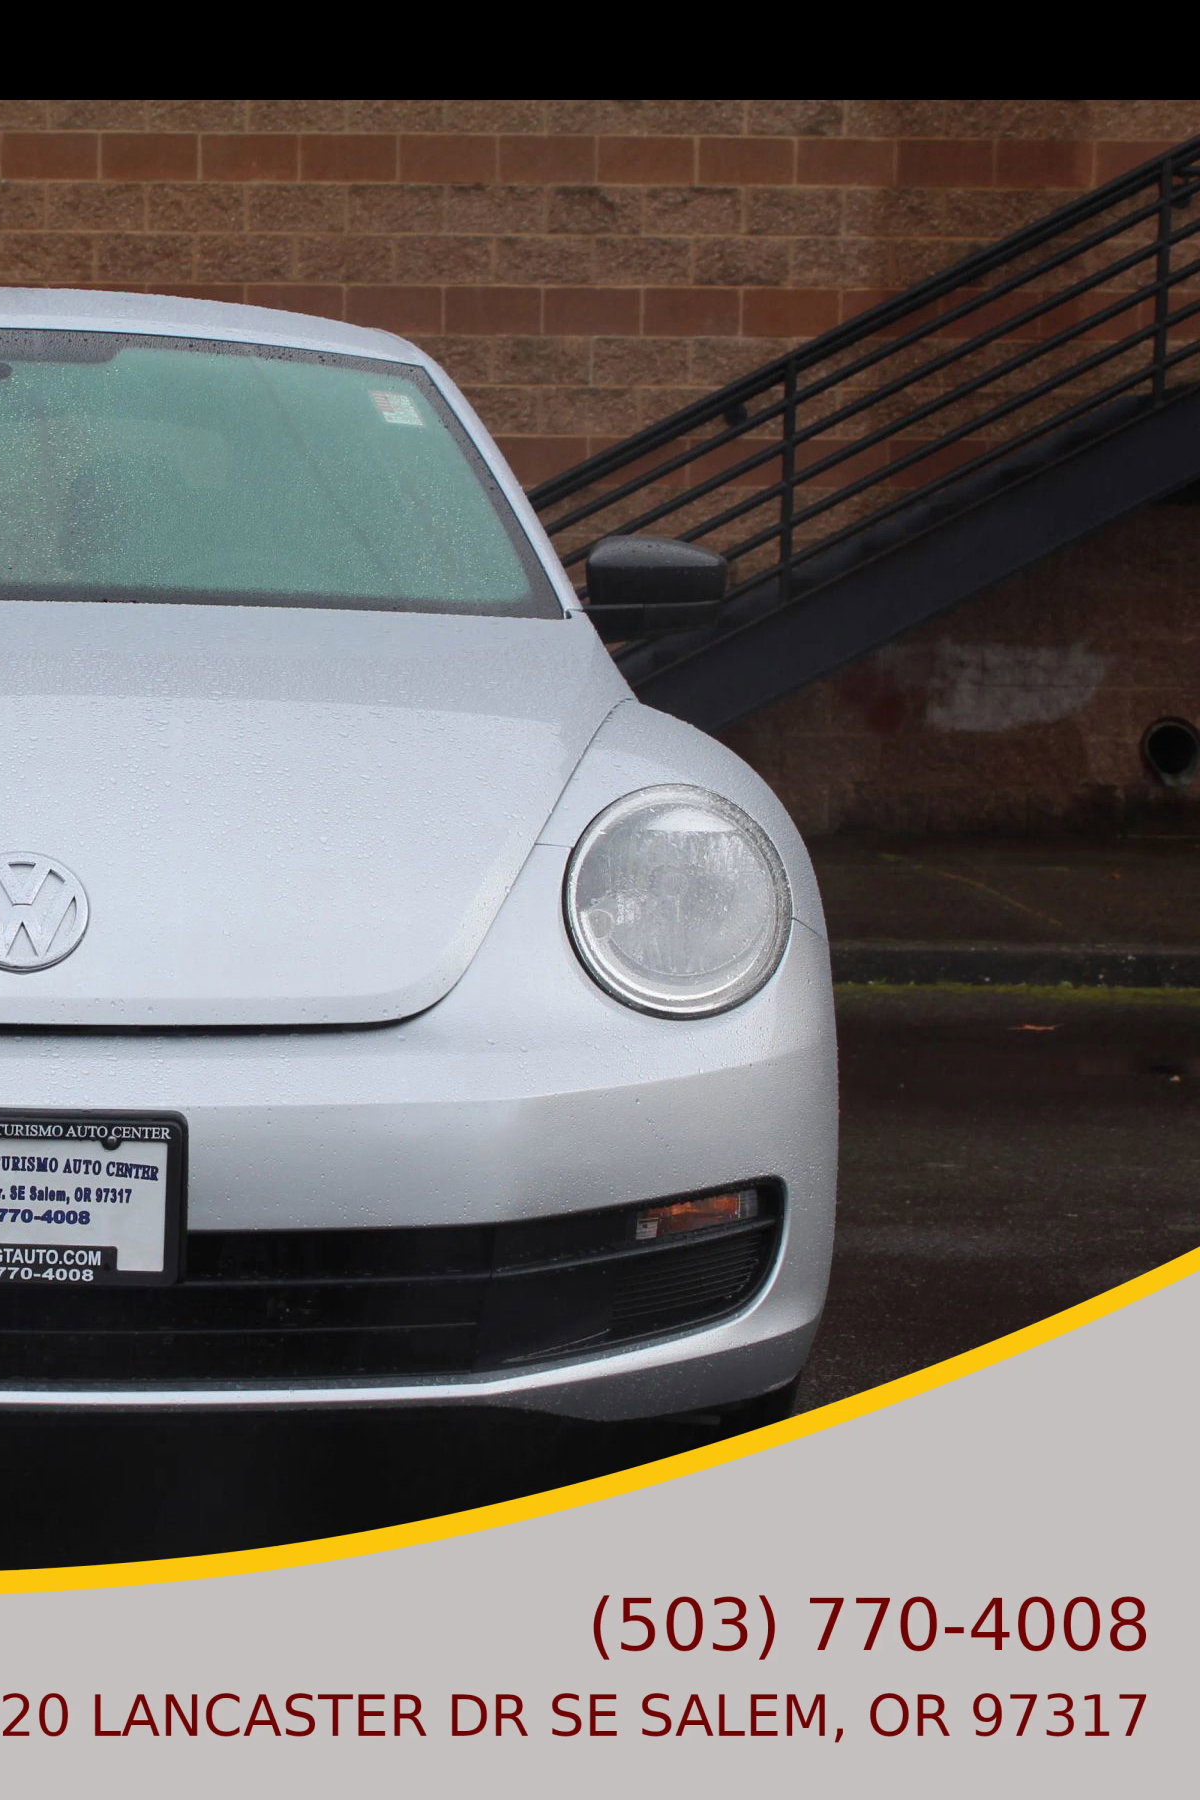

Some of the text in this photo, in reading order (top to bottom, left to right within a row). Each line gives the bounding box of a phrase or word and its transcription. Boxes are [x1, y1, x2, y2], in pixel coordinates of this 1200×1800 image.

[65, 1125, 108, 1138] AUTO
[111, 1126, 172, 1139] CENTER
[63, 1159, 102, 1175] AUTO
[106, 1161, 159, 1181] CENTER
[10, 1185, 25, 1200] SE
[29, 1185, 70, 1205] Salem,
[74, 1187, 92, 1203] OR
[95, 1188, 132, 1203] 97317
